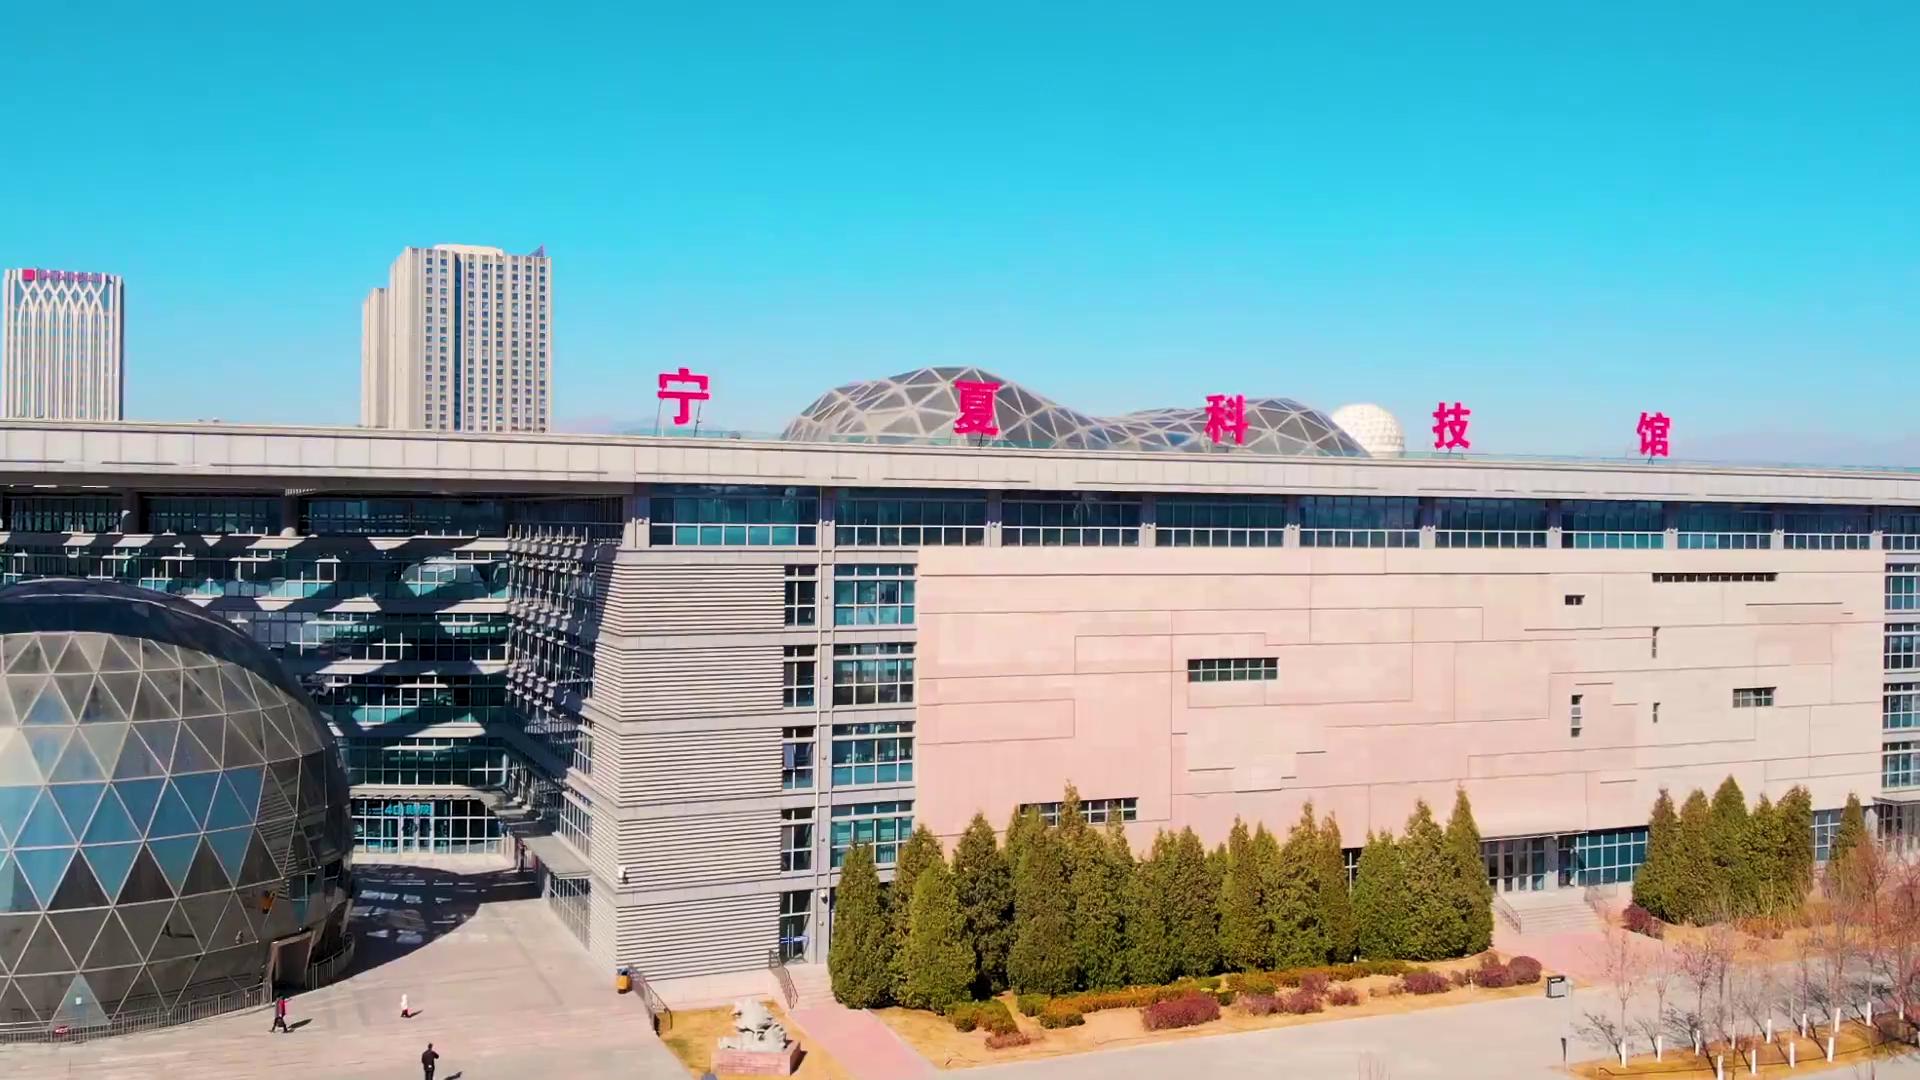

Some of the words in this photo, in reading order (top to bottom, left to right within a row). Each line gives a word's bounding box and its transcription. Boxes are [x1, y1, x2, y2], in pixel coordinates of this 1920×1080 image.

[658, 368, 1670, 456] 宁夏科技馆
